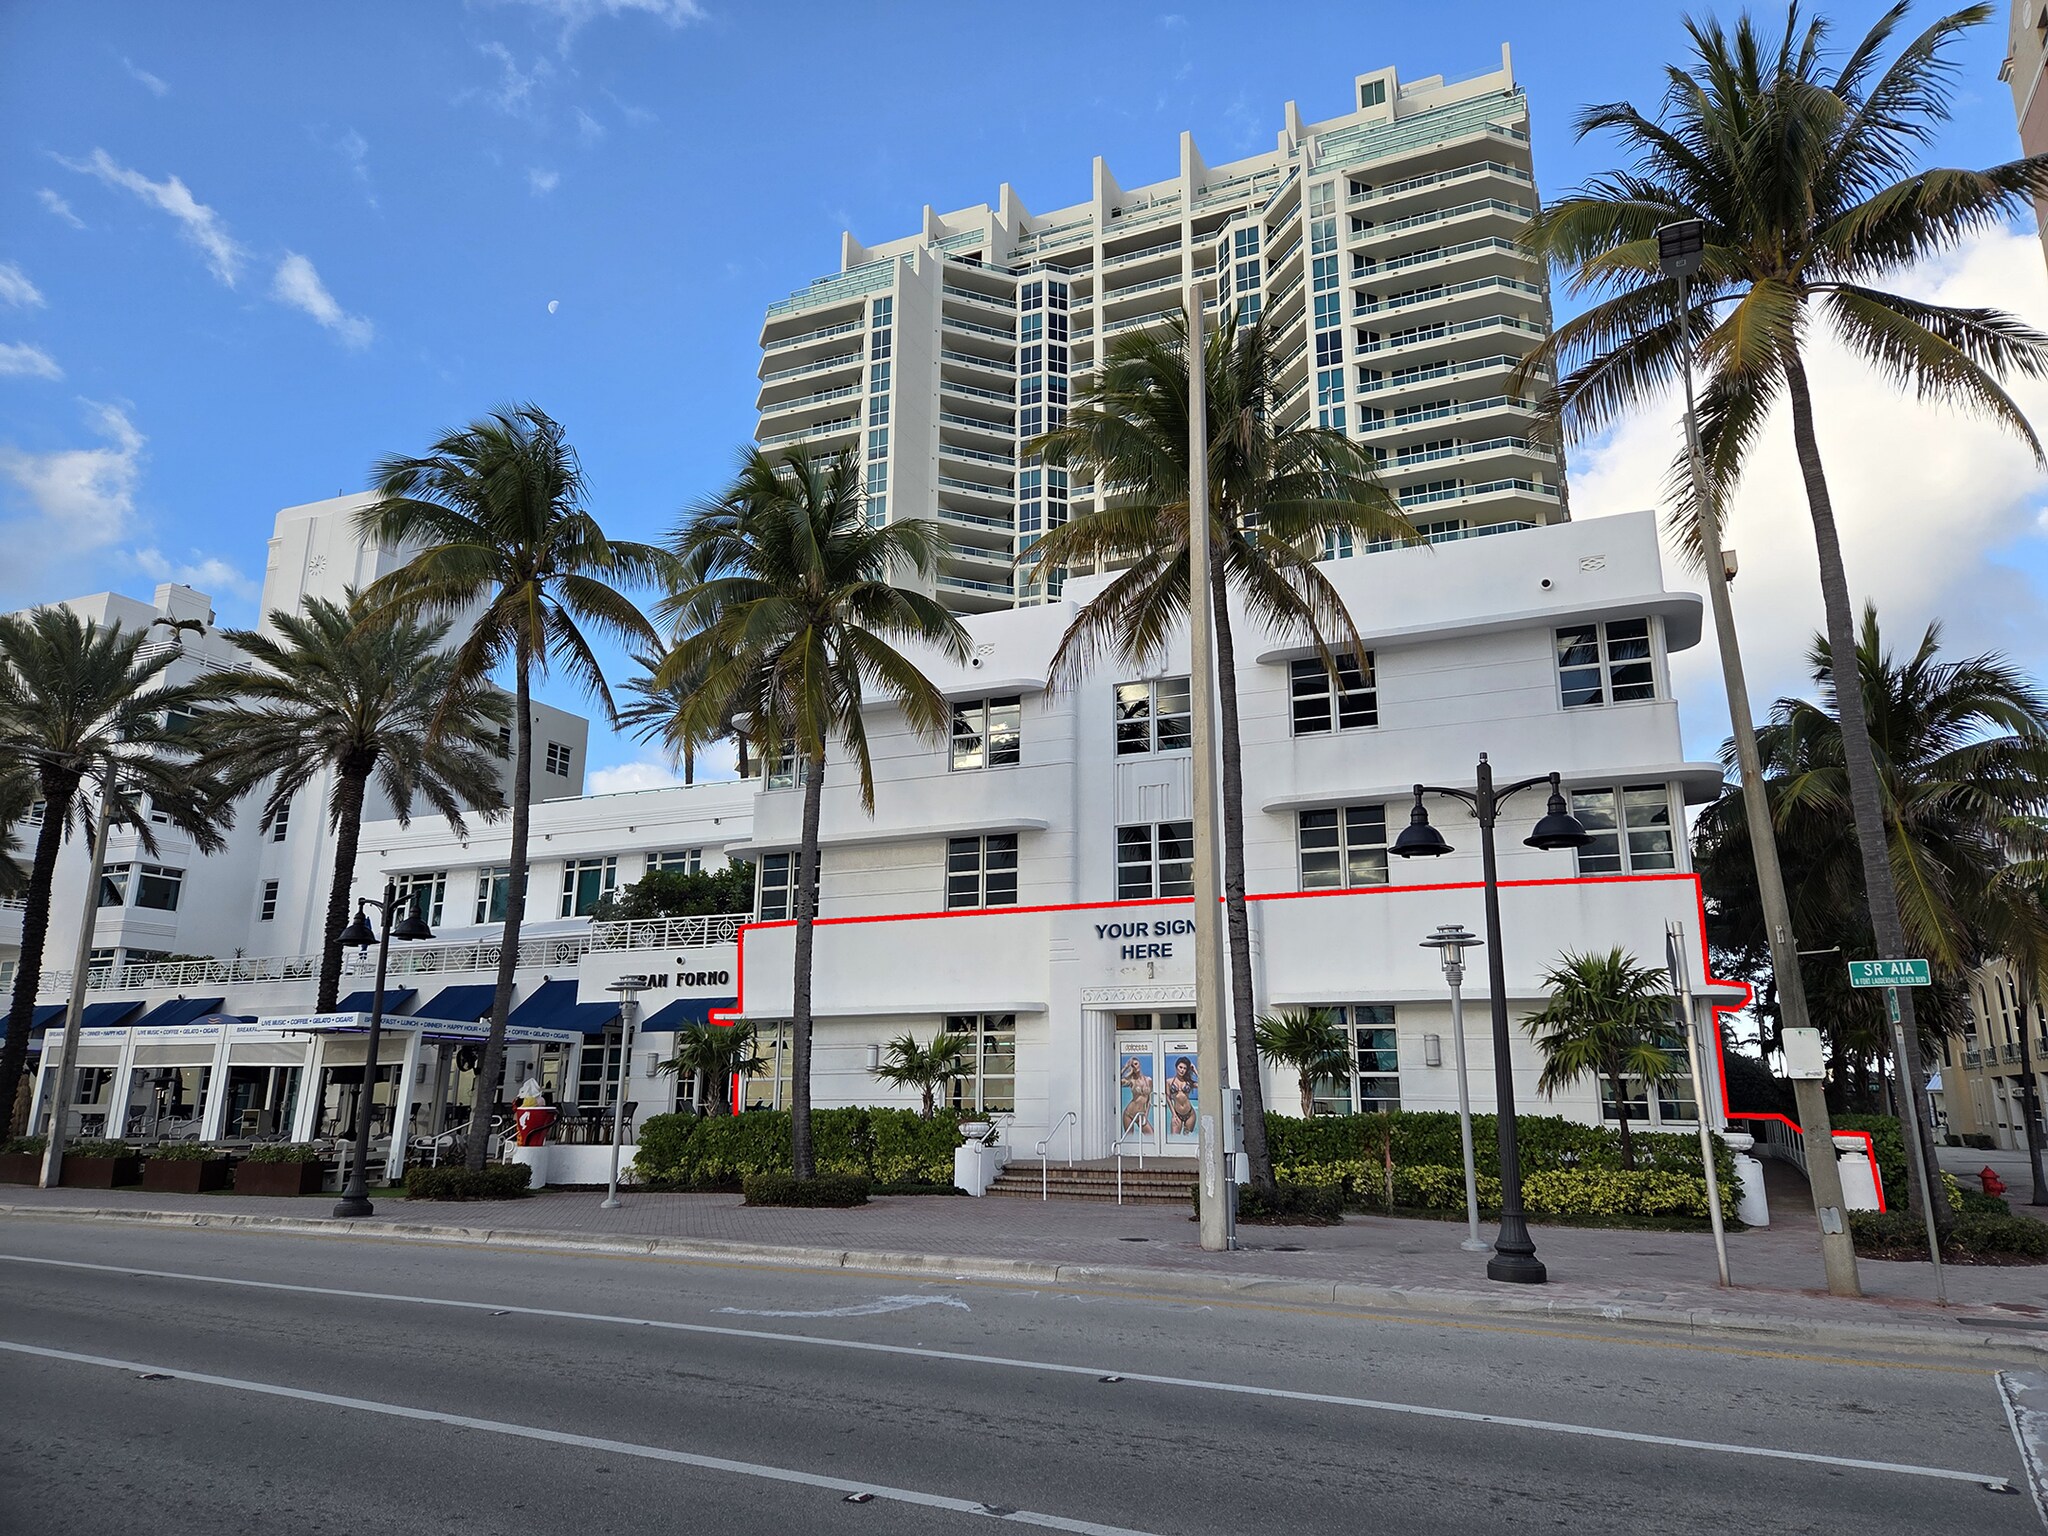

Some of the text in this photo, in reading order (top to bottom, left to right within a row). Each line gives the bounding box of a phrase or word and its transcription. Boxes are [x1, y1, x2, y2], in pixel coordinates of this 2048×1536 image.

[1095, 920, 1196, 939] YOUR SIGN
[1122, 943, 1173, 959] HERE
[1864, 962, 1914, 976] SR A1A
[628, 971, 729, 988] RAN FORNO
[1872, 977, 1899, 985] LAUDERDALE
[1900, 976, 1915, 984] BEACH
